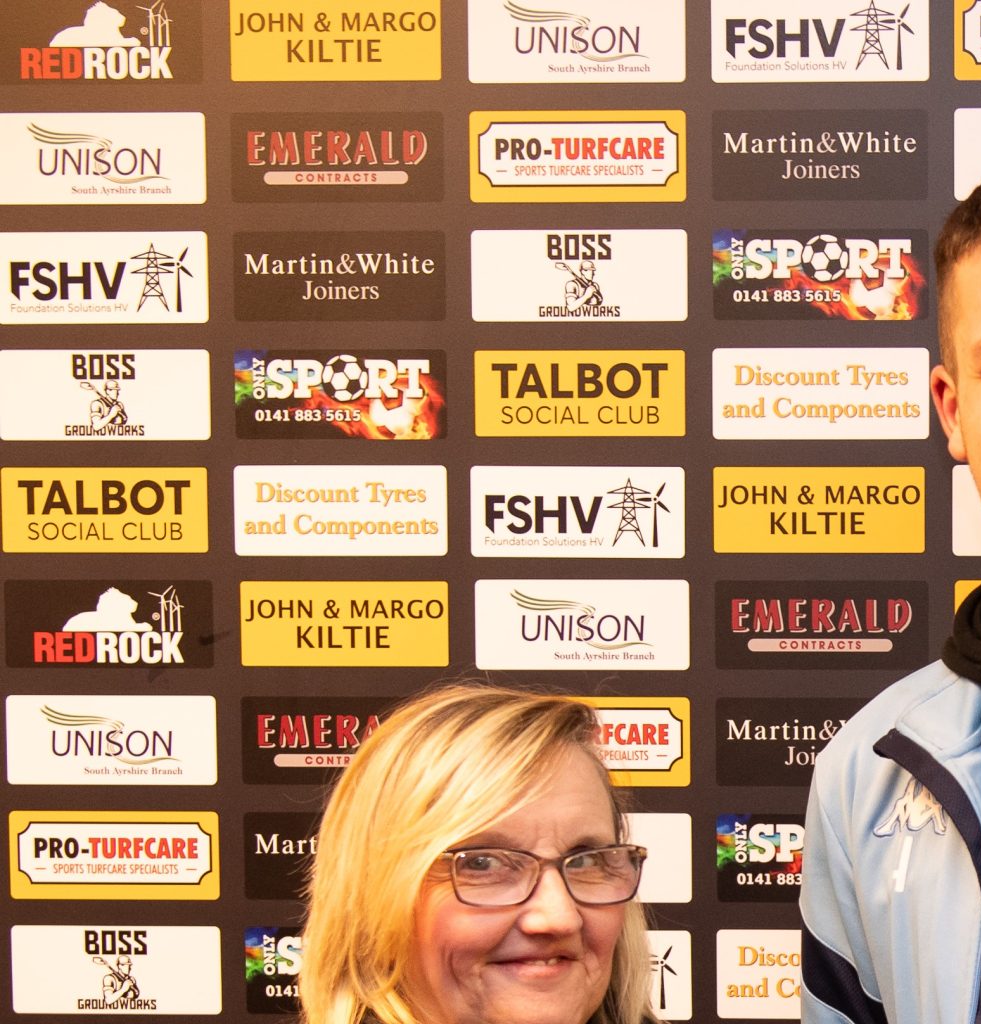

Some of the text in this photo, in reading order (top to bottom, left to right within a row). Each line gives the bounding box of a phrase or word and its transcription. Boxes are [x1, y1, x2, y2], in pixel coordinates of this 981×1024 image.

[235, 11, 436, 35] JOHN & MARGO
[514, 26, 640, 54] UNISON
[726, 18, 846, 58] FSHV
[286, 39, 382, 63] KILTIE
[20, 47, 173, 80] REDROCK
[548, 64, 650, 74] South Ayrshire Branch
[725, 62, 847, 71] Foundation Solutions HV
[247, 130, 427, 166] EMERALD
[495, 137, 664, 160] PRO-TURFCARE
[723, 132, 917, 154] Martin&White
[39, 149, 161, 176] UNISON
[514, 165, 644, 176] SPORTS TURFCARE SPECIALISTS
[782, 160, 860, 180] Joiners
[295, 173, 378, 183] CONTRACTS
[547, 234, 612, 260] BOSS
[731, 238, 744, 279] ONLY
[245, 253, 435, 275] Martin&White
[10, 262, 126, 301] FSHV
[302, 281, 379, 301] Joiners
[733, 291, 841, 302] 0141 883 5615
[10, 304, 128, 313] Foundation Solutions HV
[72, 354, 135, 380] BOSS
[253, 357, 265, 399] ONLY
[734, 365, 908, 390] Discount Tyres
[492, 363, 669, 398] TALBOT
[255, 410, 360, 422] 0141 883 5615
[501, 405, 660, 425] SOCIAL CLUB
[723, 398, 920, 422] and Components
[18, 480, 190, 515] TALBOT
[255, 482, 426, 507] Discount Tyres
[718, 485, 920, 507] JOHN & MARGO
[485, 495, 603, 534] FSHV
[769, 513, 865, 535] KILTIE
[28, 522, 183, 540] SOCIAL CLUB
[244, 514, 438, 539] and Components
[485, 537, 604, 547] Foundation Solutions HV
[245, 600, 444, 621] JOHN & MARGO
[731, 598, 912, 634] EMERALD
[296, 626, 390, 649] KILTIE
[521, 615, 644, 642] UNISON
[34, 631, 184, 663] REDROCK
[554, 651, 655, 662] South Ayrshire Branch
[779, 640, 862, 650] CONTRACTS
[51, 730, 172, 757] UNISON
[84, 767, 183, 776] South Ayrshire Branch
[34, 838, 198, 860] PRO-TURFCARE
[53, 864, 178, 874] SPORTS TURFCARE SPECIALISTS
[85, 931, 147, 955] BOSS
